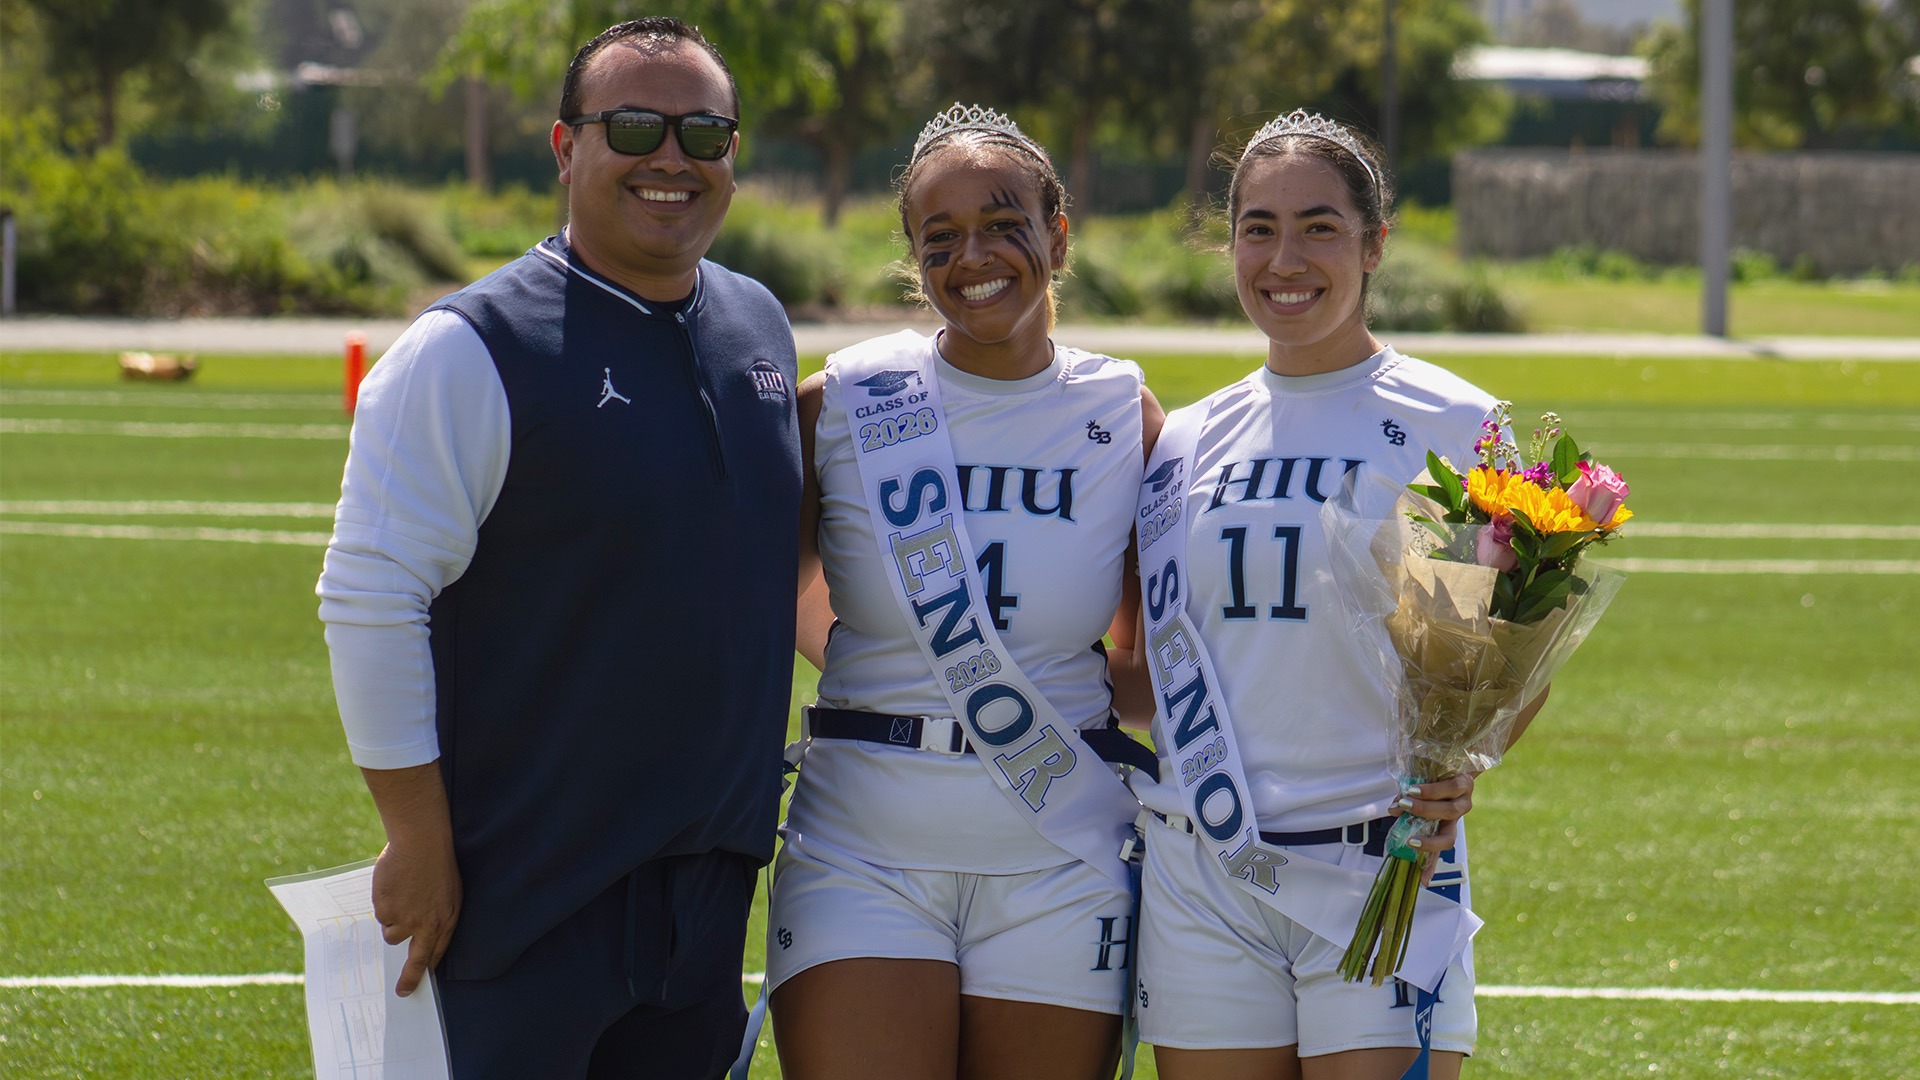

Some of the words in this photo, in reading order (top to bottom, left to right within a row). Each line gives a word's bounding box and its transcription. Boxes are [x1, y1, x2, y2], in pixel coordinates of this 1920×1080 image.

[750, 370, 787, 395] HIU
[855, 397, 904, 419] CLASS
[908, 391, 929, 405] OF
[859, 407, 938, 453] 2026
[1087, 424, 1112, 444] GB
[1383, 423, 1407, 446] GB
[1140, 491, 1169, 519] CLASS
[1170, 479, 1184, 496] OF
[1202, 457, 1367, 514] HIU
[1141, 497, 1182, 552] 2026
[976, 539, 1021, 633] 4
[1218, 523, 1309, 622] 11
[945, 649, 1001, 694] 2026
[1181, 736, 1228, 787] 2026
